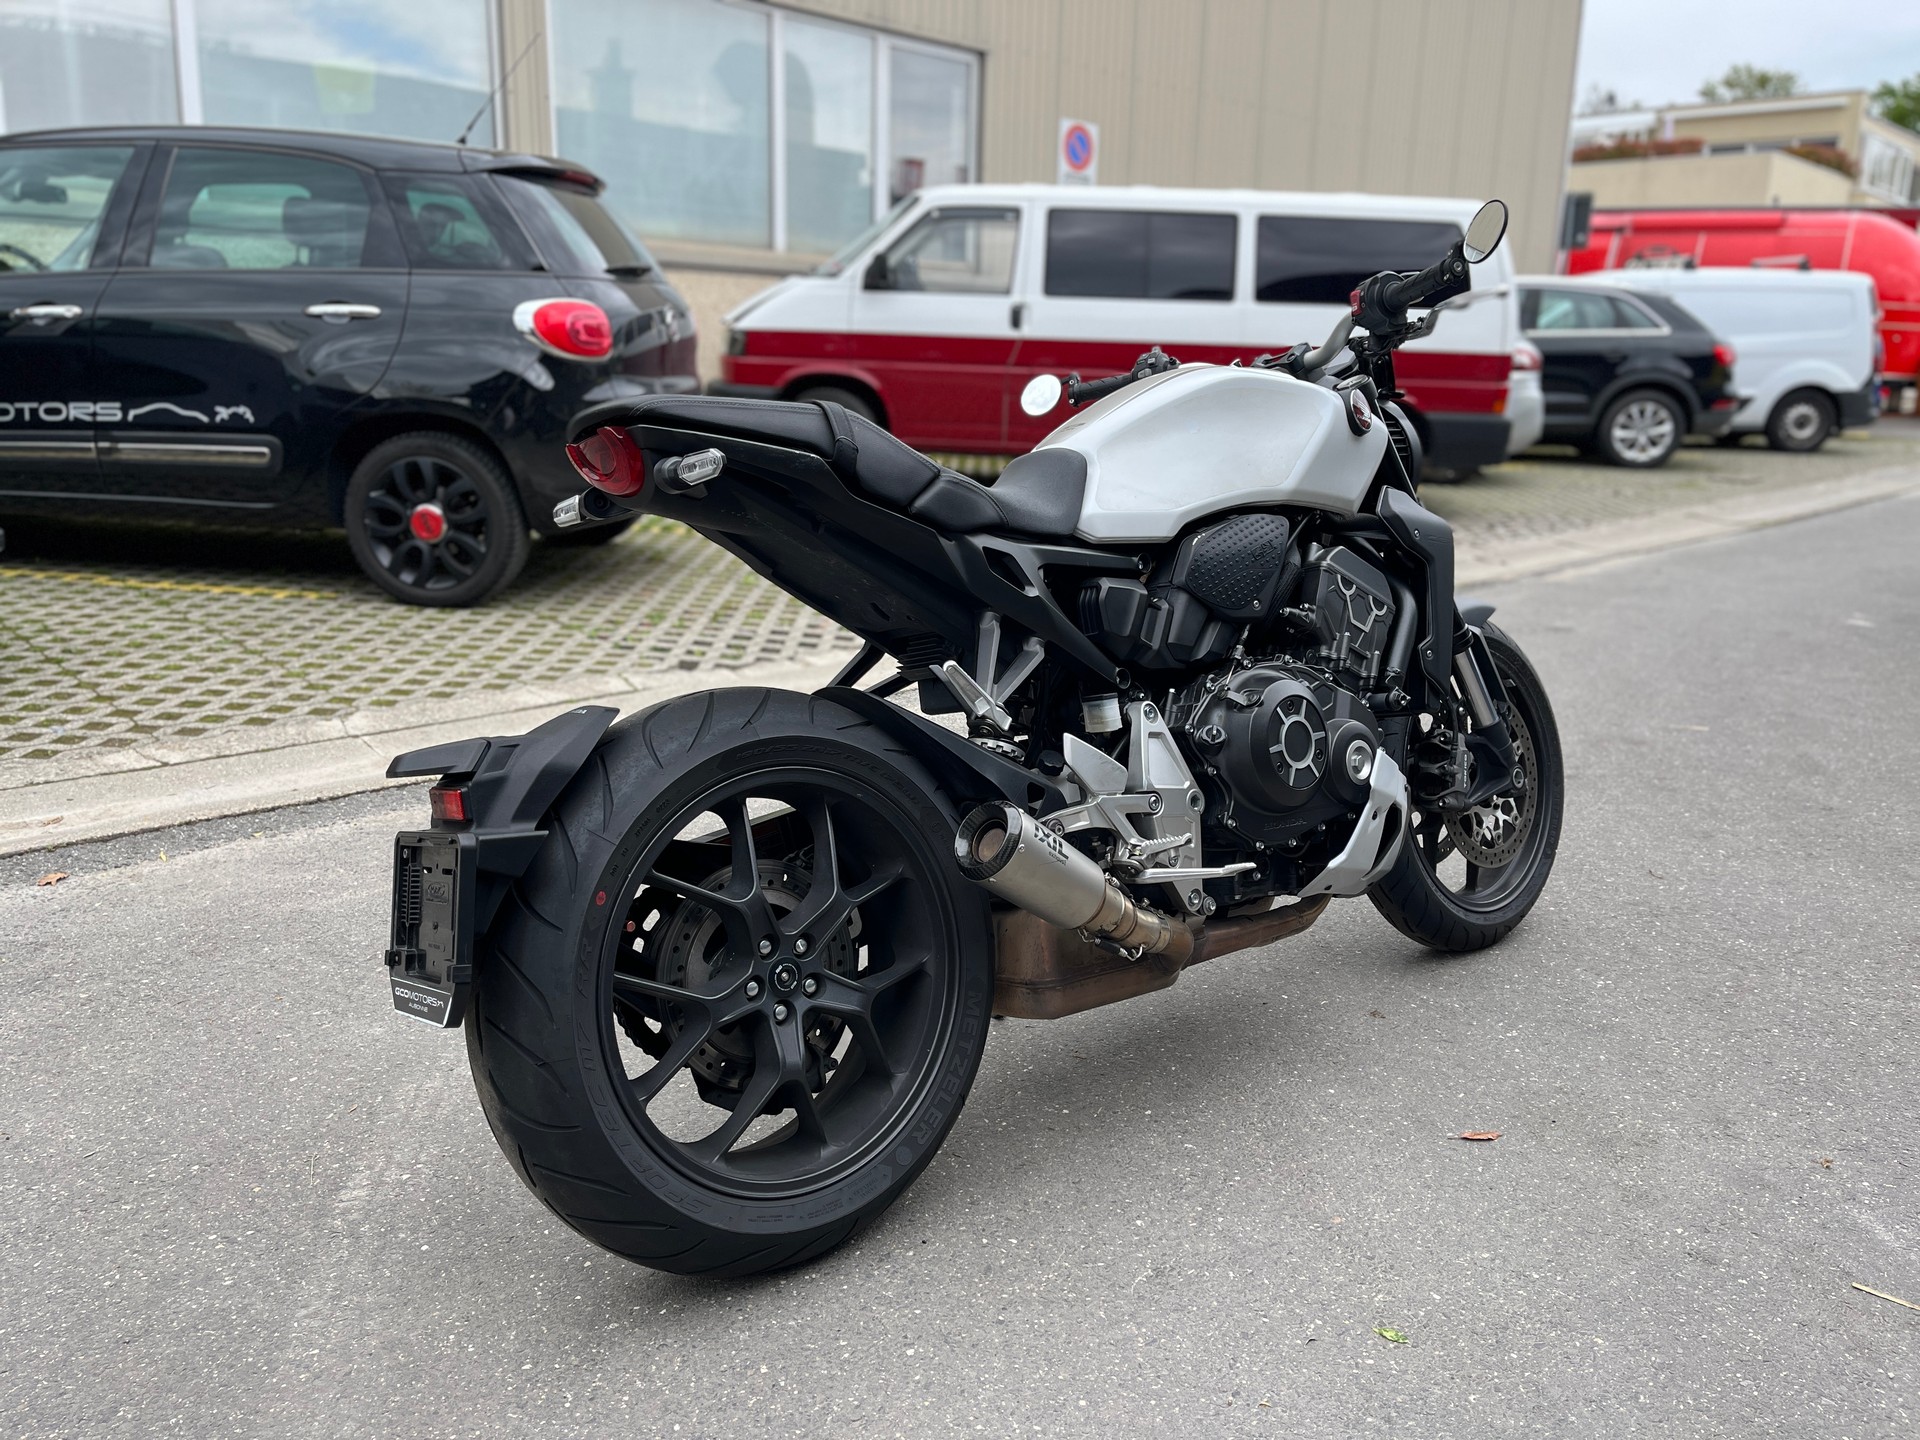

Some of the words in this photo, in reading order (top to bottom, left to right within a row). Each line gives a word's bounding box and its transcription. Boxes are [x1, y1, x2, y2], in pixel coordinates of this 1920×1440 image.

[1034, 823, 1069, 860] IXIL
[910, 990, 982, 1148] METZELER
[587, 1078, 711, 1222] SPORTEC
